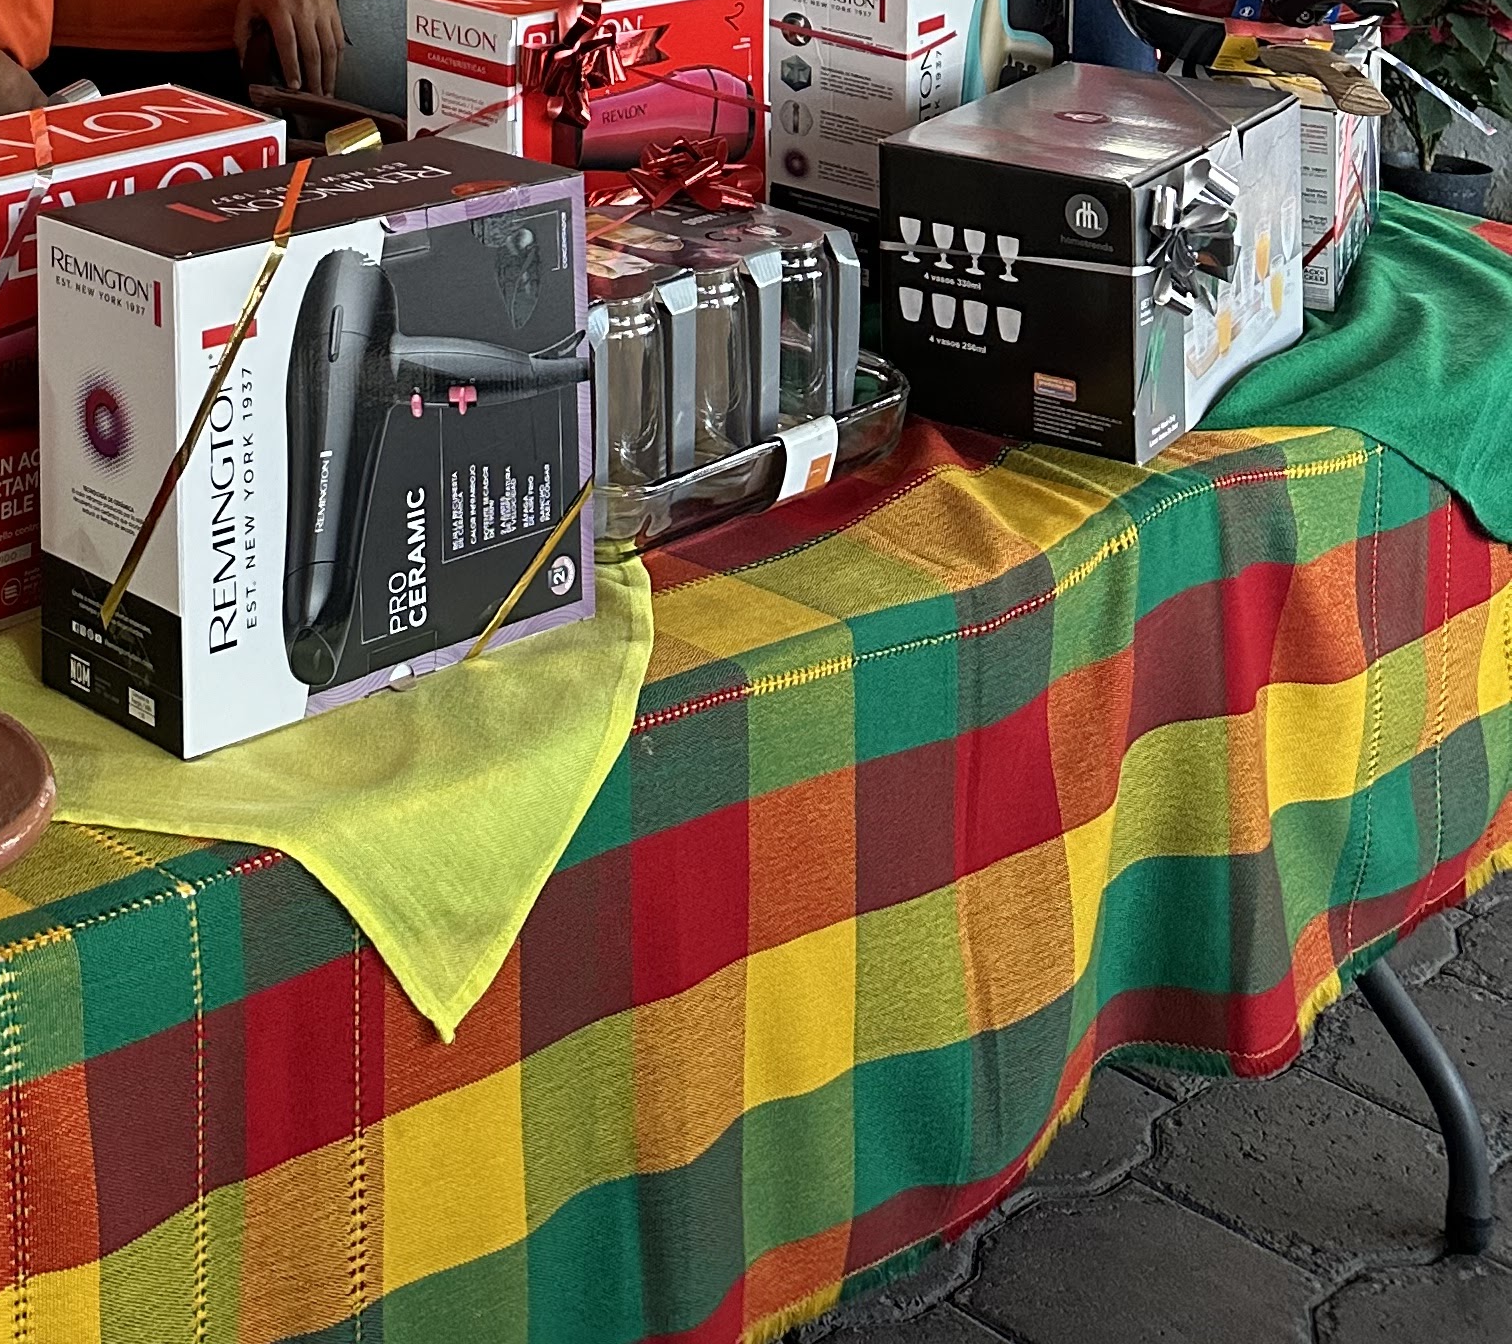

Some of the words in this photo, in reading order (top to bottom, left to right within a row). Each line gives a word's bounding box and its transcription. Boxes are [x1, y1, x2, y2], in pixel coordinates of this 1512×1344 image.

[810, 0, 828, 8] NEW
[831, 4, 852, 13] YORK
[416, 15, 497, 53] REVLON
[602, 103, 648, 124] REVLON
[321, 169, 365, 183] NEW
[211, 192, 255, 205] 1937
[51, 245, 149, 301] REMINGTON
[923, 272, 929, 280] 4
[931, 274, 955, 285] vasos
[56, 275, 72, 289] EST.
[75, 283, 95, 297] NEW
[99, 291, 123, 308] YORK
[126, 300, 146, 316] 1937
[929, 334, 935, 343] 4
[936, 337, 961, 349] vasos
[962, 342, 987, 354] 250ml
[241, 367, 254, 420] 1937
[243, 431, 256, 502] YORK
[315, 460, 331, 534] REMINGTON
[244, 515, 257, 569] NEW
[406, 486, 428, 628] CERAMIC
[245, 581, 257, 630] EST.
[389, 571, 409, 635] PRO
[70, 658, 91, 688] NOM
